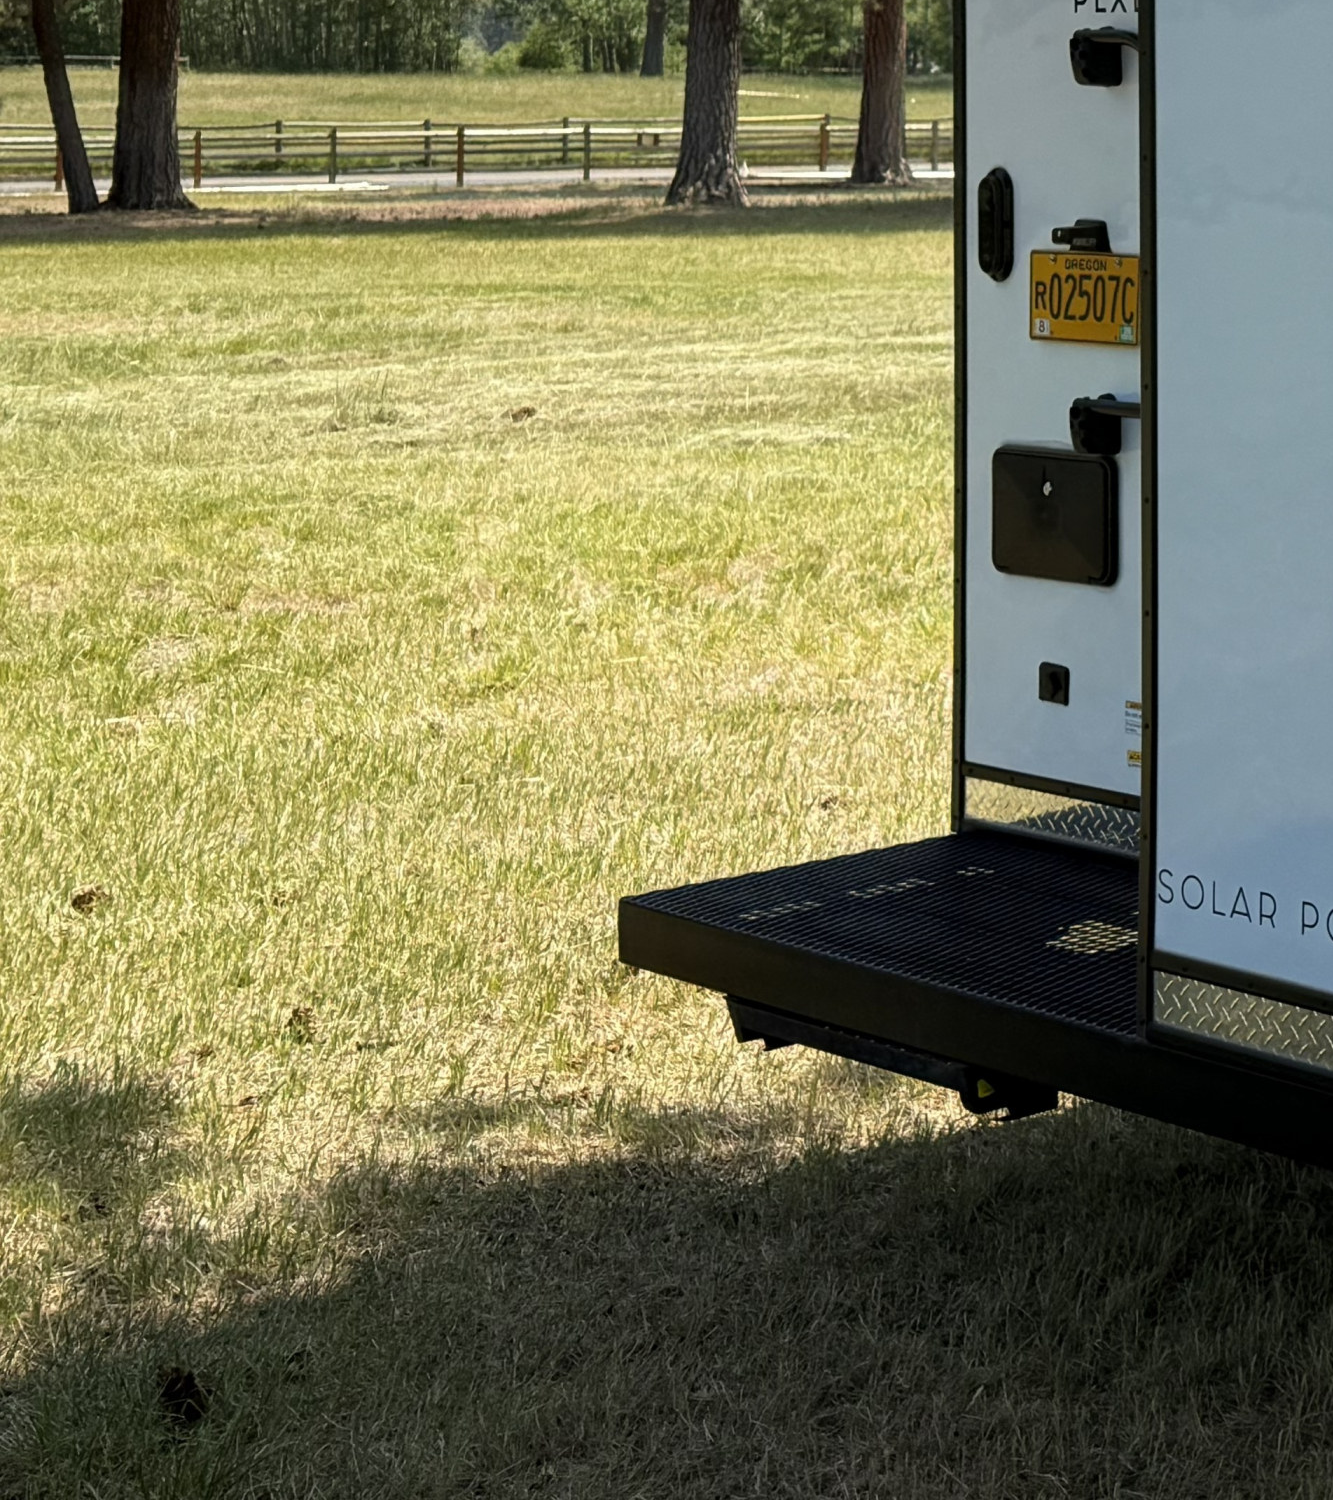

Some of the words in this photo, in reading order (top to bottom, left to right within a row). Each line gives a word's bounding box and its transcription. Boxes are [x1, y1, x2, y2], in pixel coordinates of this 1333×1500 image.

[1065, 258, 1107, 271] OREGON
[1034, 273, 1135, 325] R02507C
[1158, 868, 1278, 929] SOLAR
